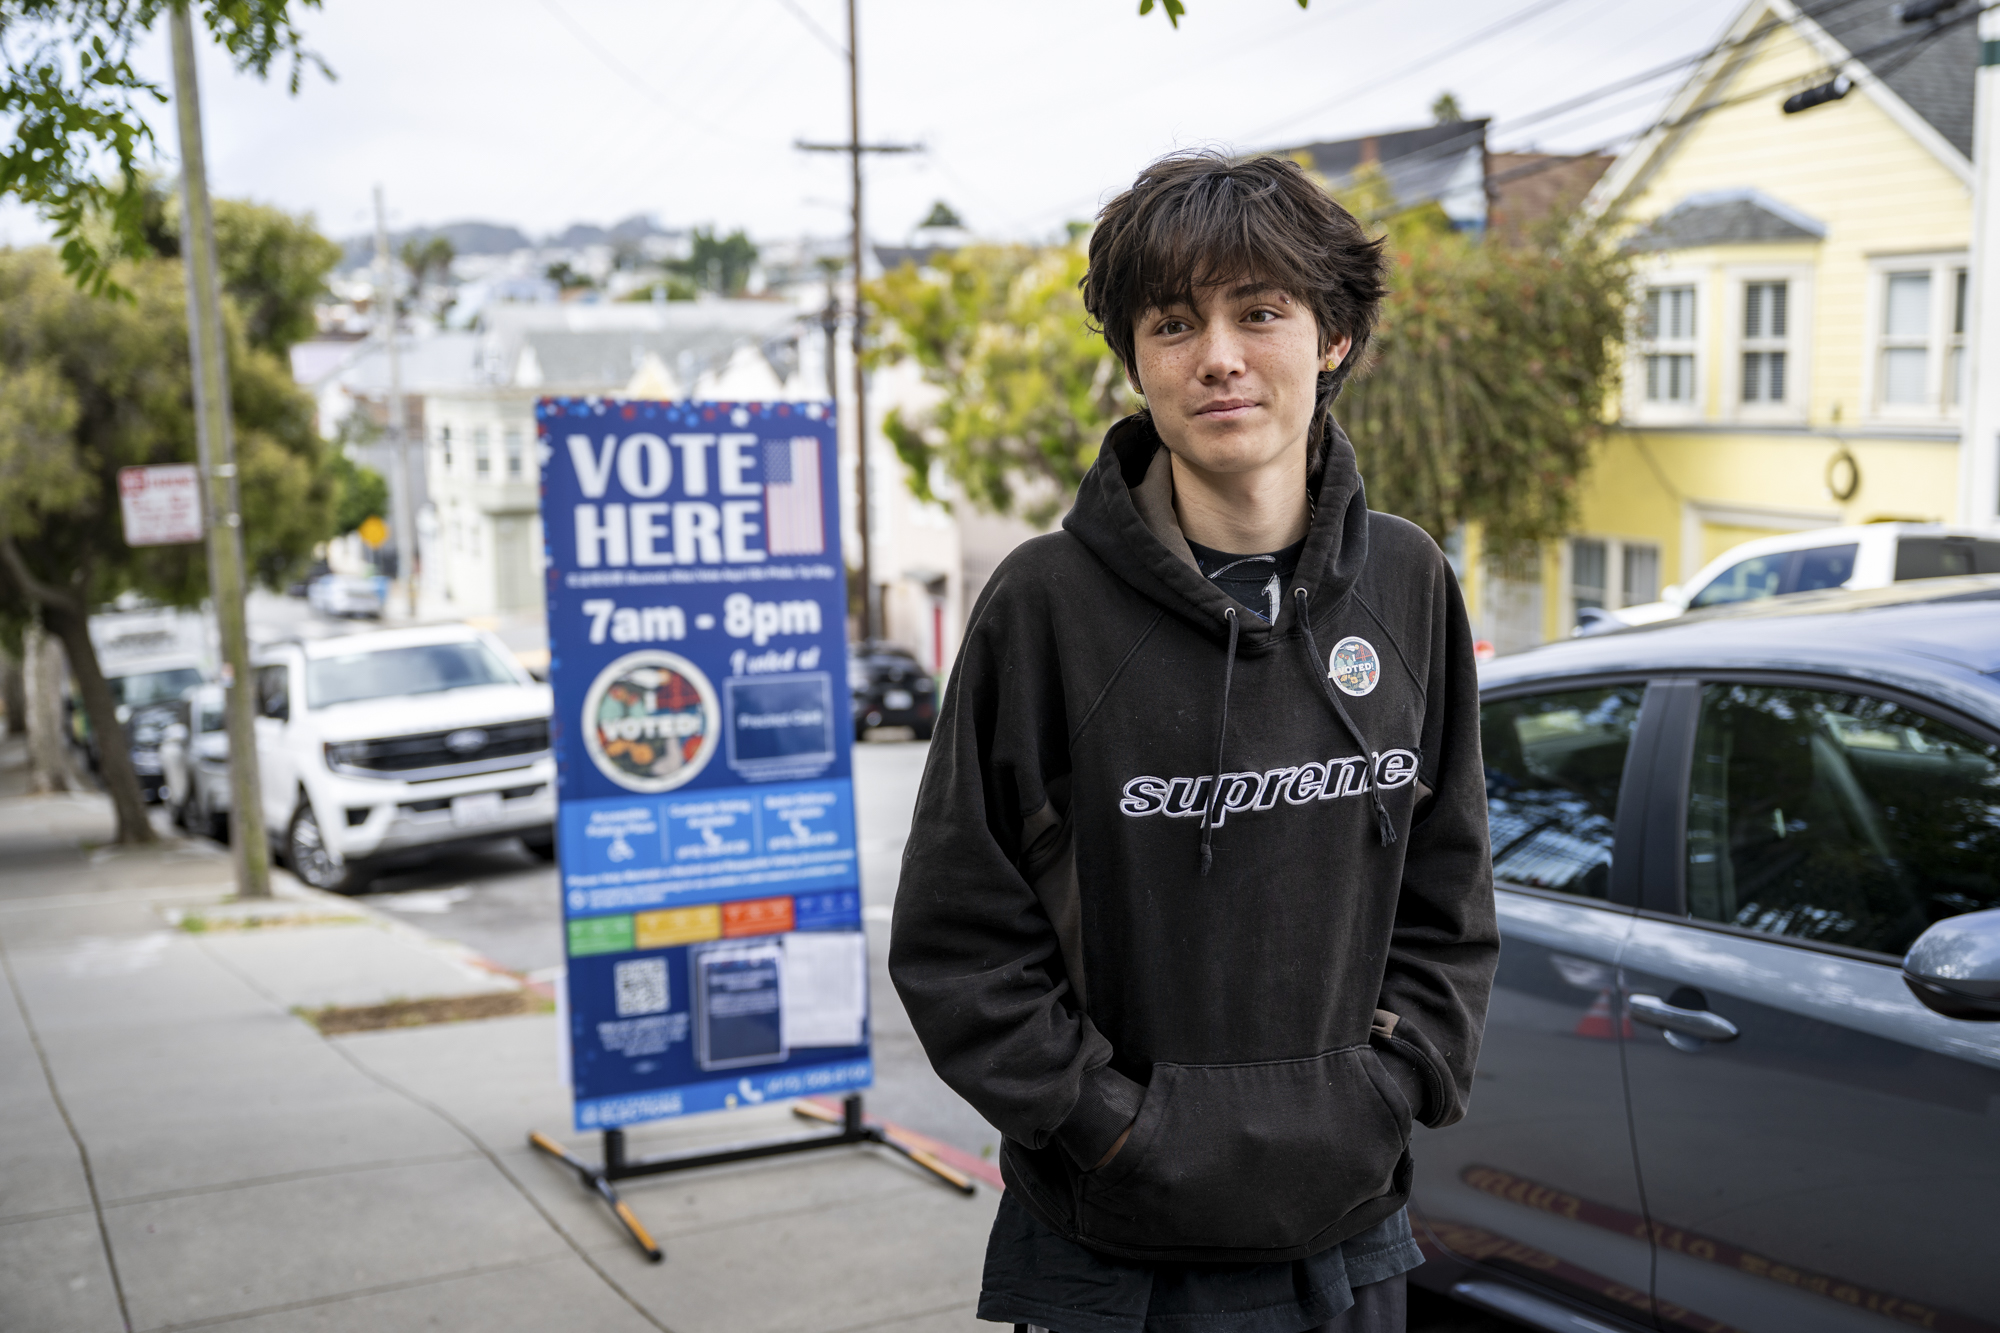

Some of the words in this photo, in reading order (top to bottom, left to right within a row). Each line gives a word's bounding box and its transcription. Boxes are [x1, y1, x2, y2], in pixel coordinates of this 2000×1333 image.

[566, 432, 762, 498] VOTE
[574, 500, 767, 568] HERE
[581, 598, 687, 645] 7am
[694, 613, 716, 630] -
[723, 592, 822, 647] 8pm
[600, 714, 702, 740] VOTED!
[1120, 748, 1419, 828] supreme
